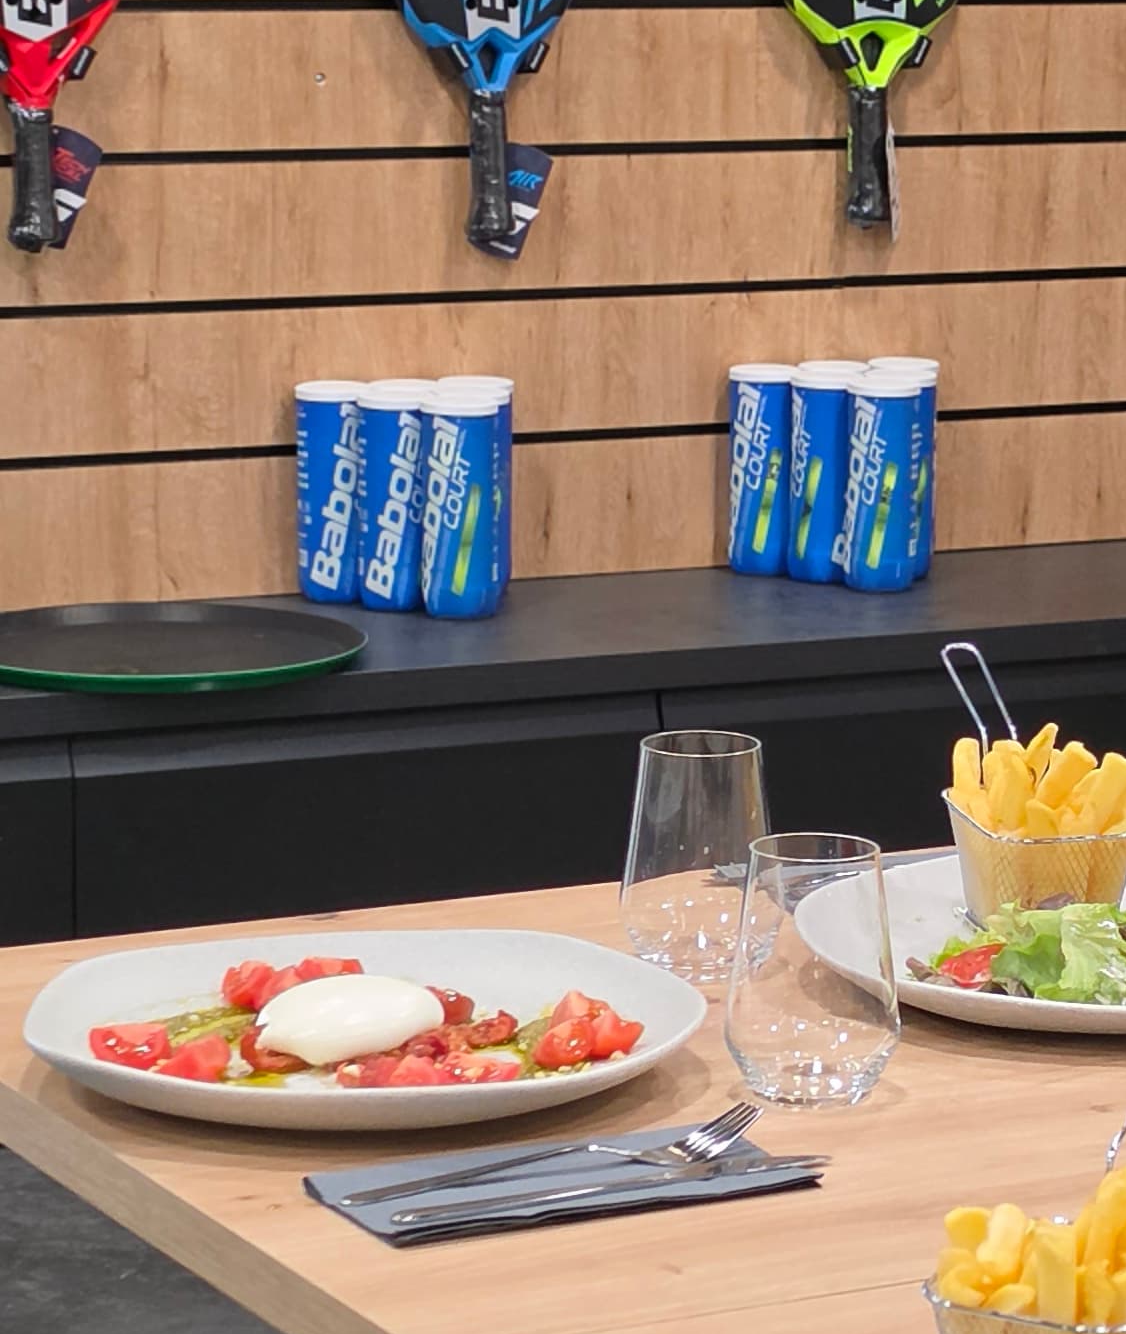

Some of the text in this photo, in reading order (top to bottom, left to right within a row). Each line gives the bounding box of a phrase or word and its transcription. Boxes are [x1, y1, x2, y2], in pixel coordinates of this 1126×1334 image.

[443, 451, 471, 530] COURT
[745, 422, 771, 490] COURT
[792, 431, 811, 498] COURT
[861, 434, 887, 505] COURT
[310, 402, 362, 590] Babolat
[365, 411, 421, 599] Babolat
